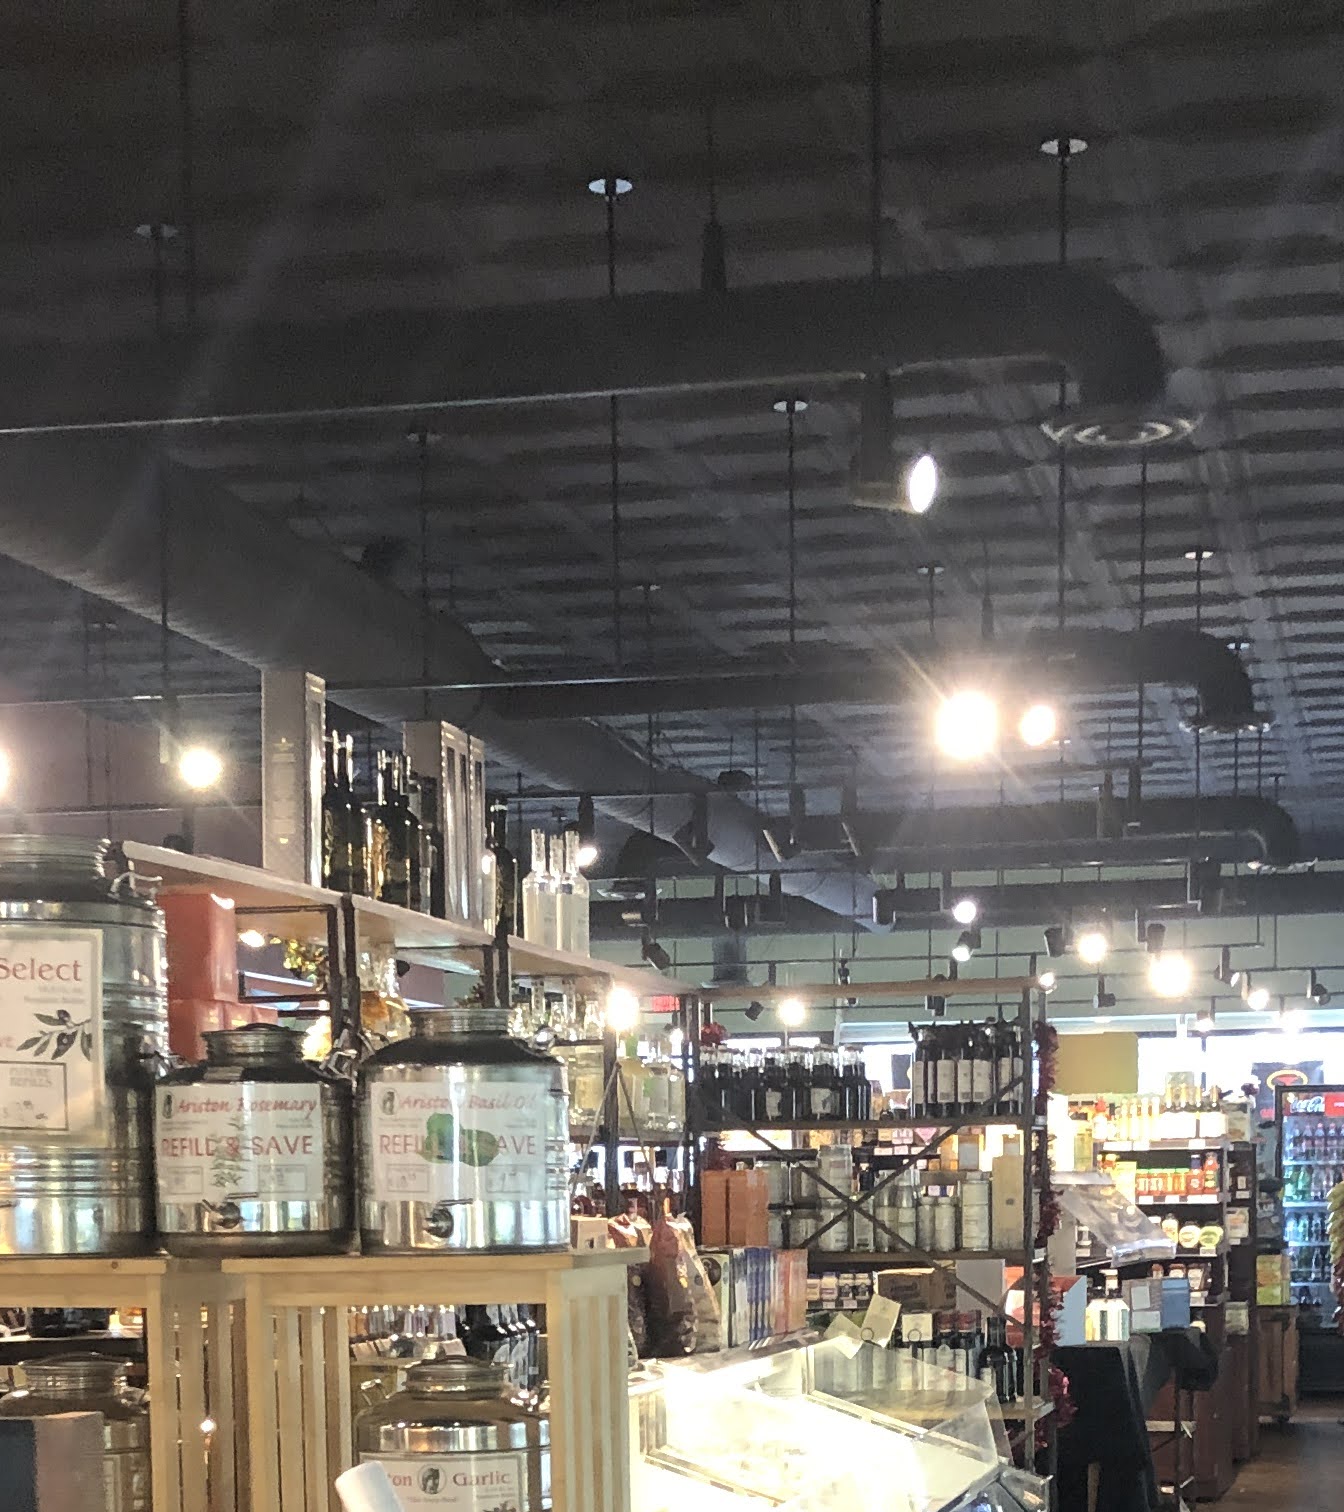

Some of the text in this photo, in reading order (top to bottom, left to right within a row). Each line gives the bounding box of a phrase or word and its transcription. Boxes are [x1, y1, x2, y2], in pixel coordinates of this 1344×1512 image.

[161, 1137, 215, 1157] REFILL
[251, 1135, 313, 1156] SAVE
[486, 1135, 535, 1155] AVE
[452, 1471, 511, 1487] Garlic
